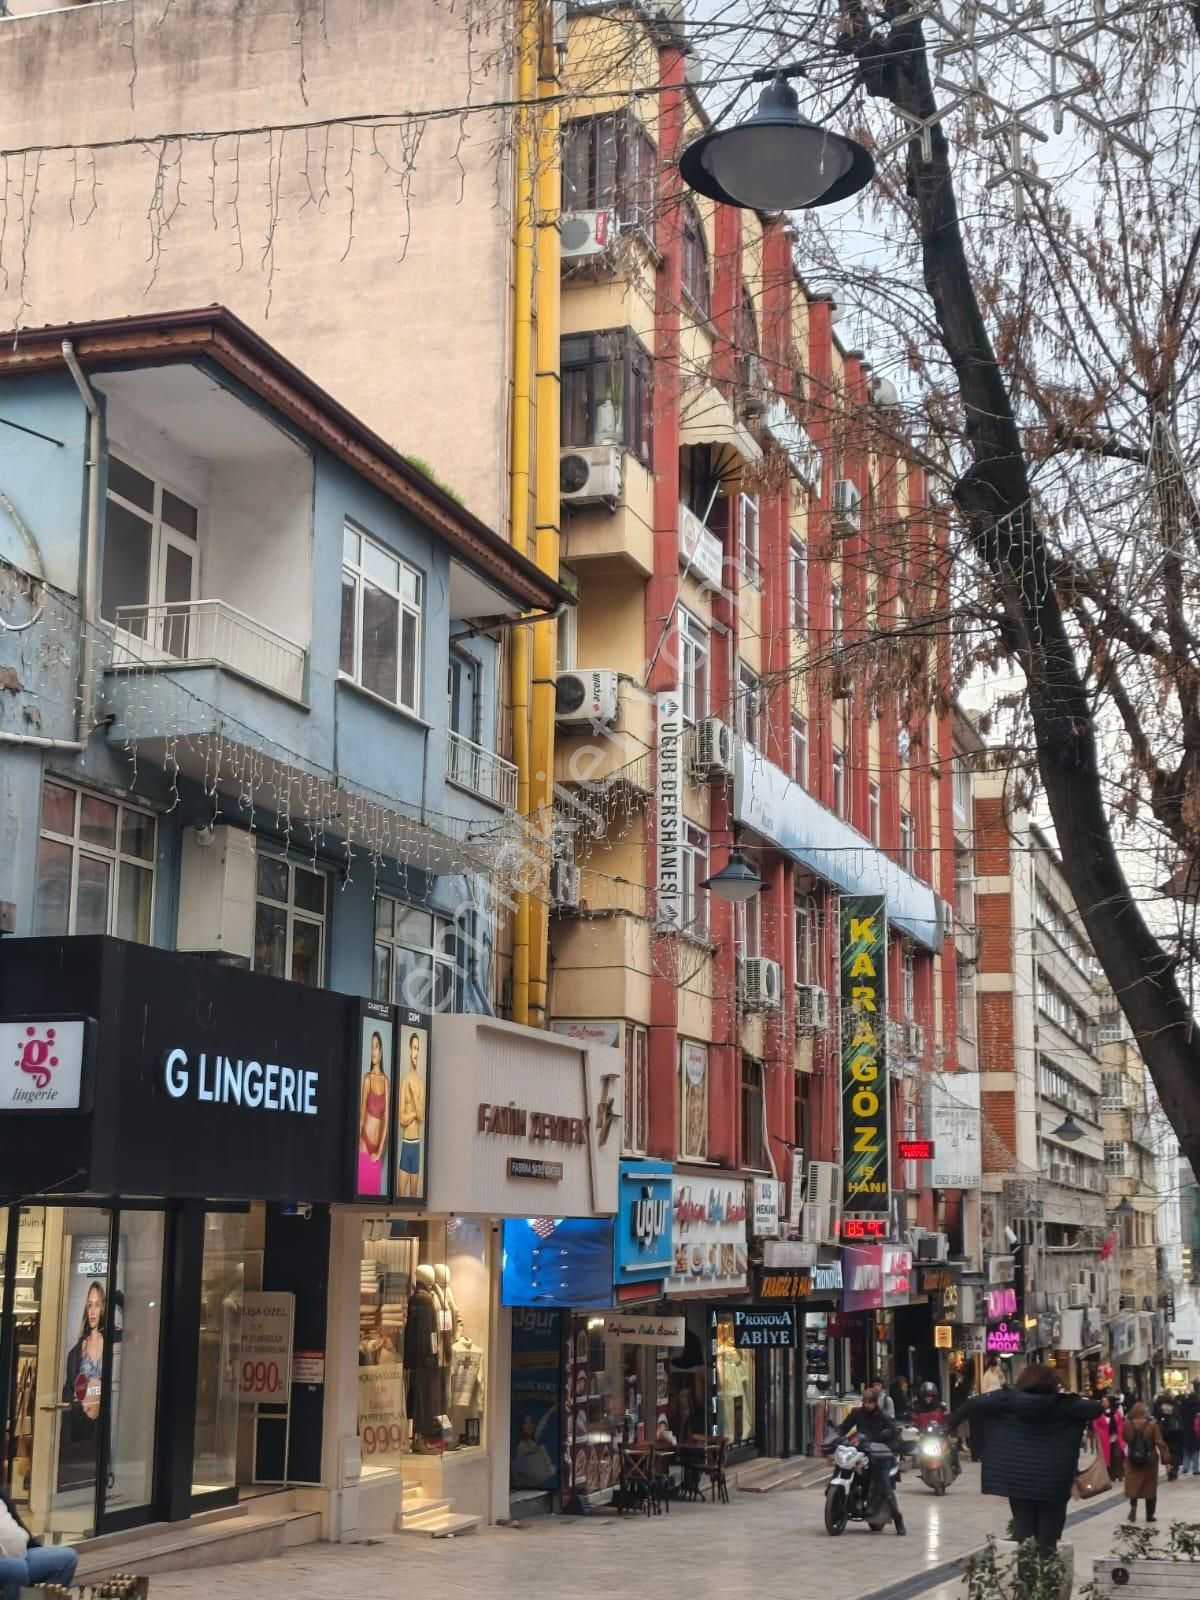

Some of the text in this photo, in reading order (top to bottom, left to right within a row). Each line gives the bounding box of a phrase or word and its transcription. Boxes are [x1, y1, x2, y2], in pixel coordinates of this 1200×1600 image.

[850, 916, 879, 1152] KARAGÖZ
[165, 1048, 319, 1115] G LINGERIE
[12, 1087, 59, 1104] lingerie
[848, 1182, 887, 1193] HANI
[735, 1311, 792, 1326] PRONOVA
[1000, 1322, 1008, 1332] O
[740, 1330, 790, 1345] ABİYE
[988, 1332, 1020, 1342] ADAM
[987, 1342, 1019, 1351] MODA
